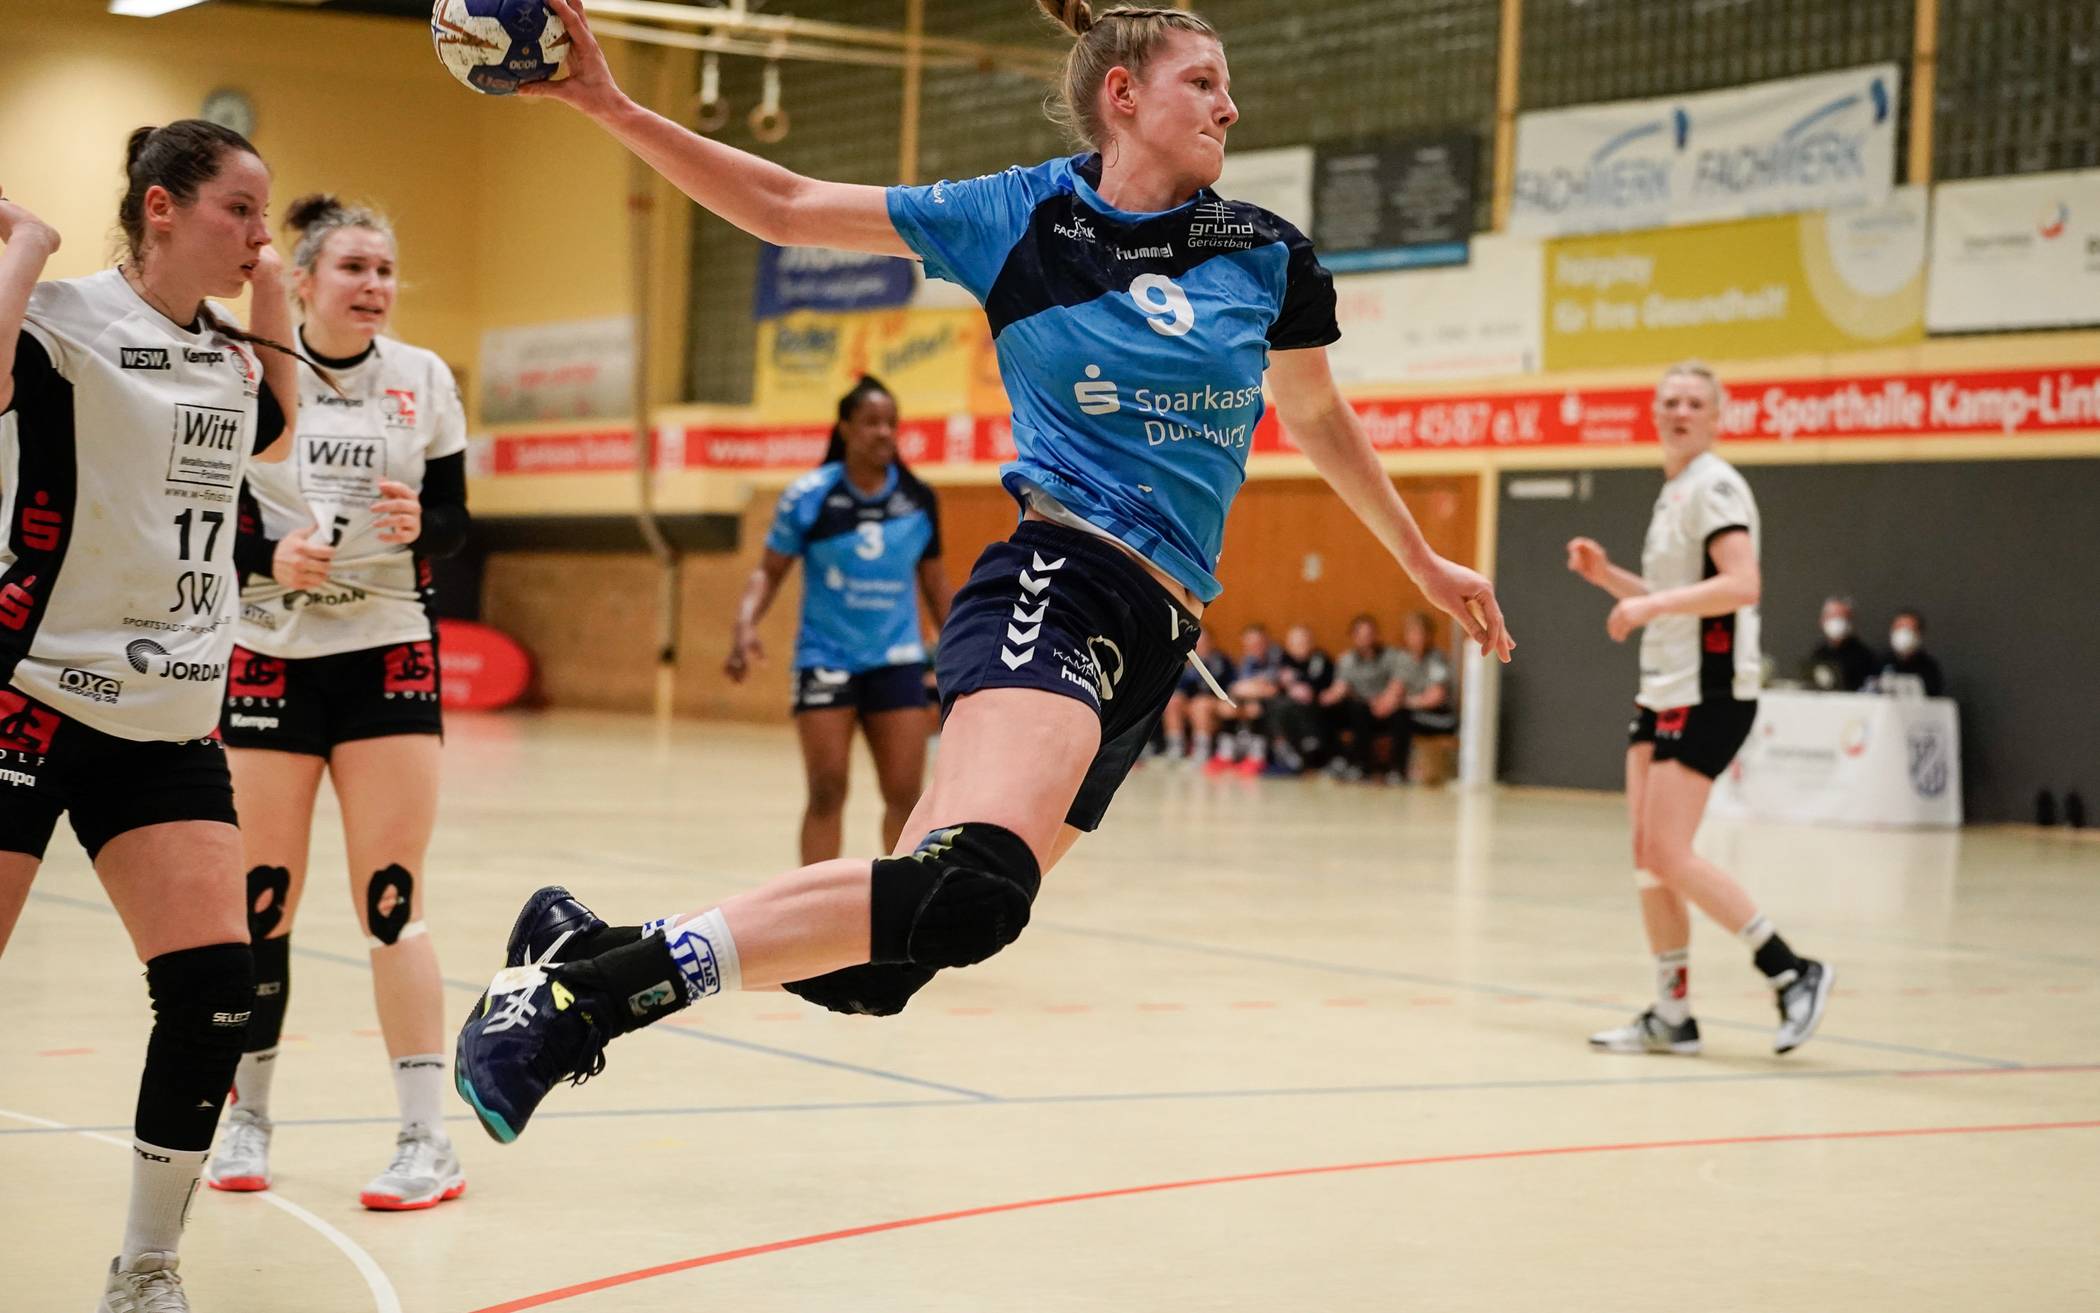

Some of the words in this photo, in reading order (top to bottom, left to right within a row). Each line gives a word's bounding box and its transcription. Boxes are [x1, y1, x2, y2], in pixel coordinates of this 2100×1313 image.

[1116, 243, 1174, 261] hummel
[1187, 237, 1252, 249] Gerüstbau
[1129, 273, 1195, 336] 9
[1135, 384, 1261, 416] Sparkasse
[1763, 381, 1922, 438] Sporthalle
[184, 411, 237, 450] Witt
[309, 440, 376, 468] Witt
[174, 508, 225, 562] 17
[855, 521, 885, 561] 3
[159, 661, 225, 682] JORDA
[230, 713, 279, 730] Kempa
[0, 749, 45, 766] OLF
[0, 768, 36, 787] mpa
[212, 1011, 251, 1023] SELECT
